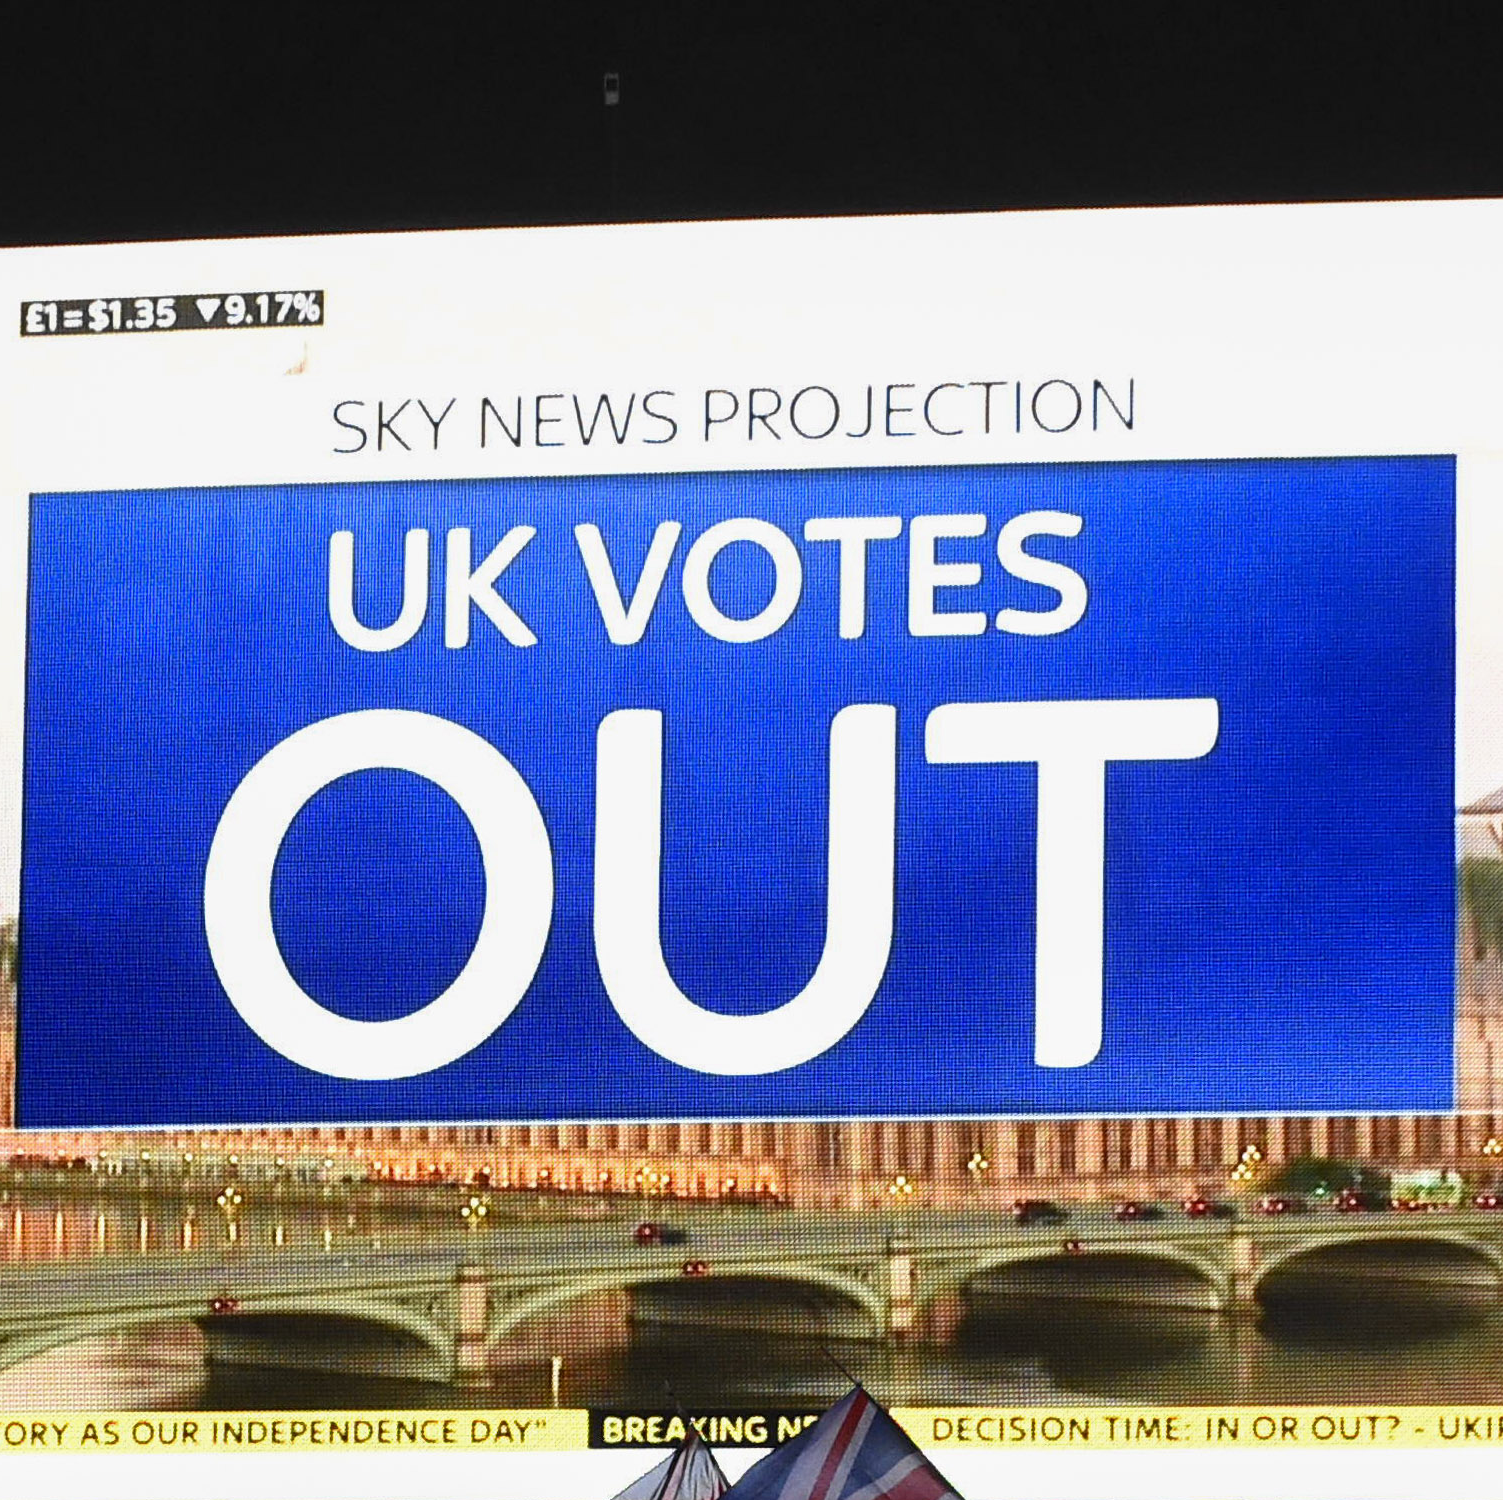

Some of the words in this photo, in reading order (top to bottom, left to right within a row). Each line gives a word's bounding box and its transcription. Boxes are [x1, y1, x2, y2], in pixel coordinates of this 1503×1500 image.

[26, 298, 177, 333] £1=$1.35
[332, 398, 457, 454] SKY
[480, 390, 678, 449] NEWS
[703, 377, 1136, 443] PROJECTION
[329, 525, 538, 652] UK
[574, 510, 1088, 646] VOTES
[203, 697, 1220, 1081] OUT
[81, 1421, 120, 1446] AS
[132, 1421, 199, 1446] OUR
[212, 1419, 455, 1445] INDEPENDENCE
[932, 1416, 1091, 1442] DECISION
[1206, 1416, 1239, 1441] IN
[1252, 1415, 1299, 1441] OR
[1311, 1414, 1402, 1441] OUT?
